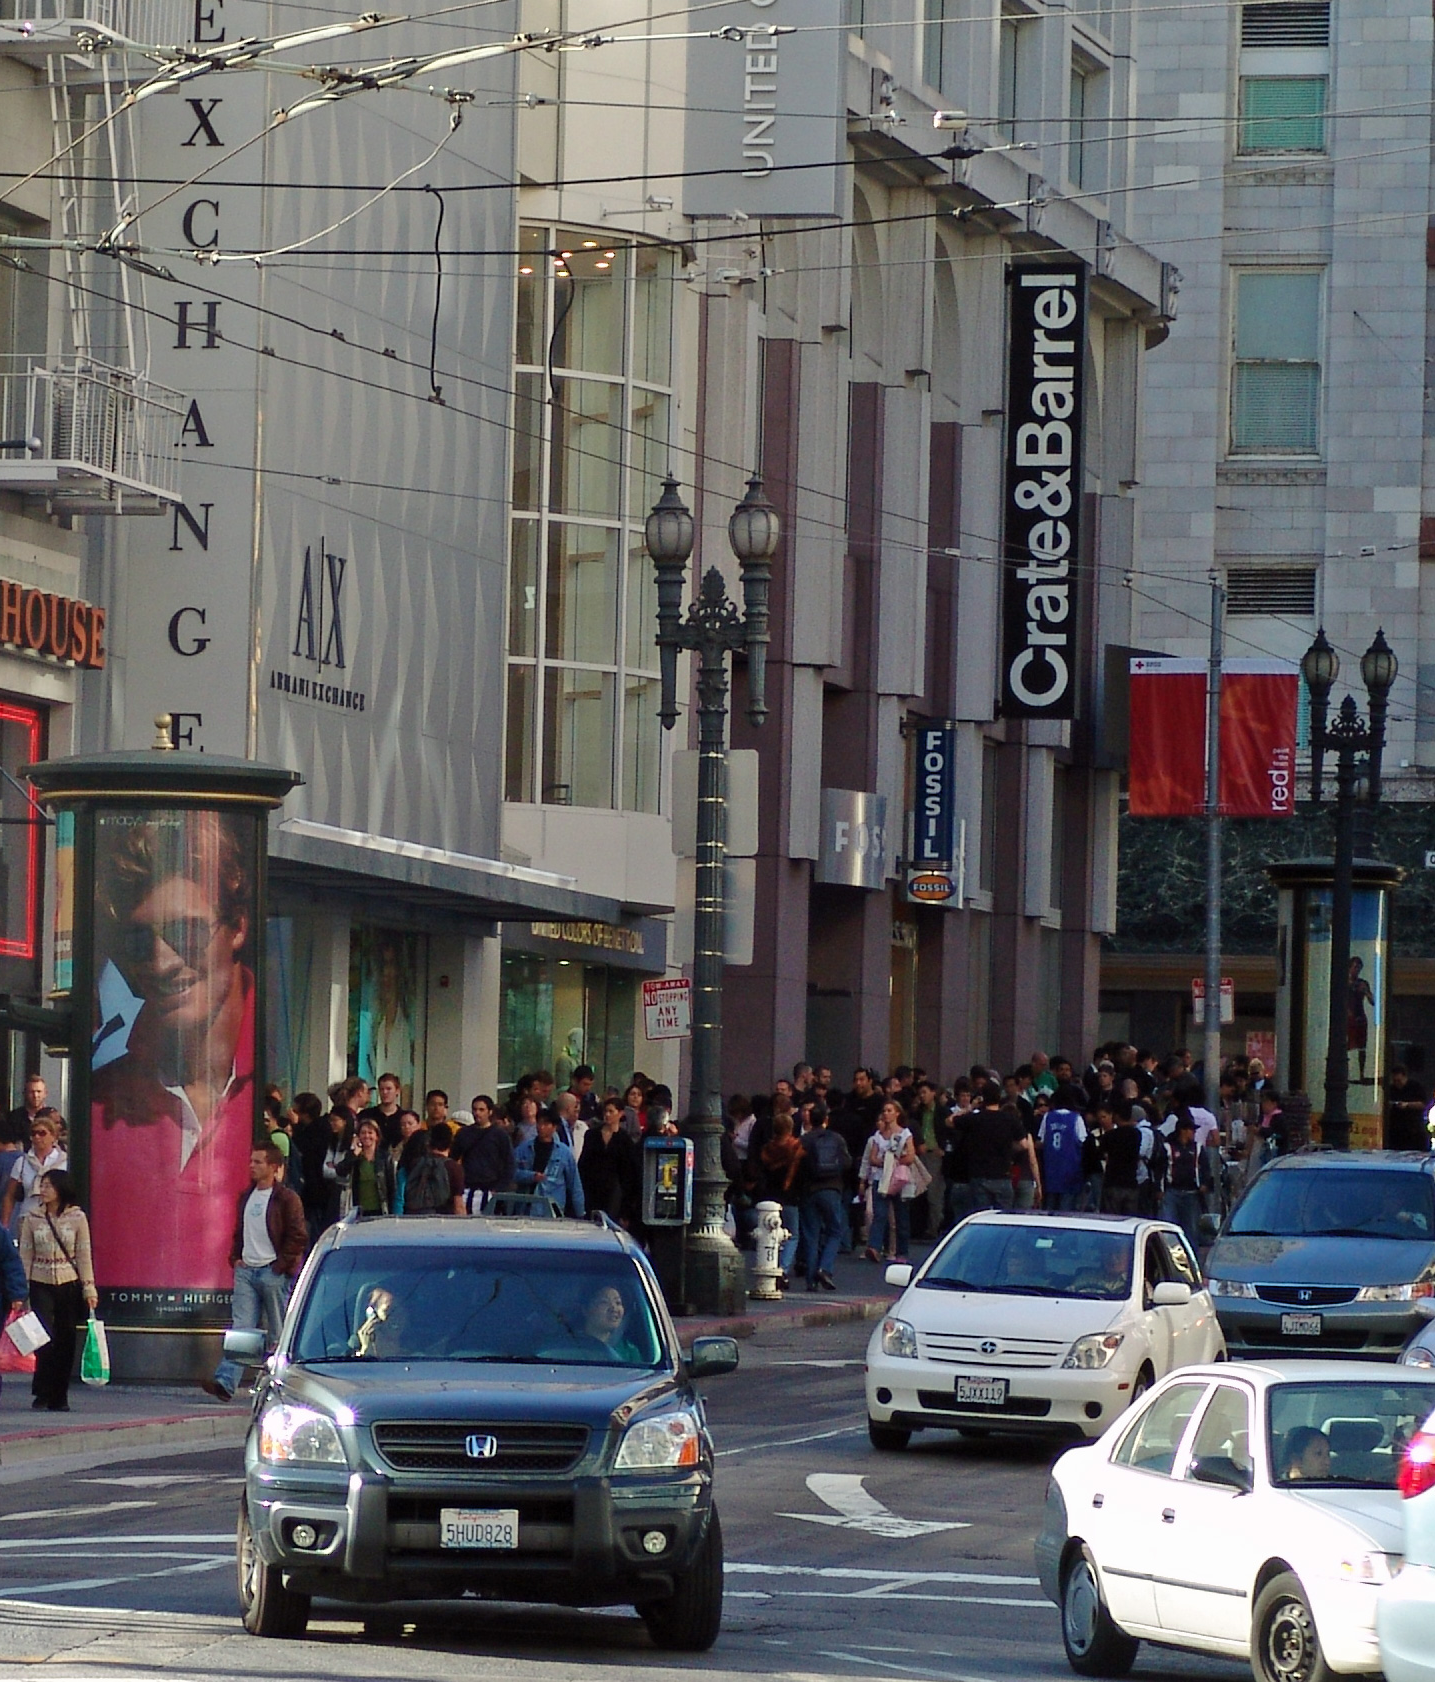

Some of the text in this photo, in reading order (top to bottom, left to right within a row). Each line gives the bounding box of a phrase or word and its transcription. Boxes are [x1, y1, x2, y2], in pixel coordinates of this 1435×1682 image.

[741, 22, 779, 178] UNITED
[1009, 273, 1077, 707] Crate&Barrel
[270, 669, 365, 712] ARMANI EXCHANGE
[923, 731, 944, 858] FOSSIL
[1267, 770, 1288, 810] red
[913, 884, 951, 893] FOSSIL
[645, 991, 657, 1005] NO
[659, 1005, 677, 1017] ANY
[657, 1018, 680, 1028] TIME
[1052, 1132, 1061, 1150] 8
[109, 1292, 164, 1302] TOMMY
[446, 1523, 513, 1543] 5HUD828
